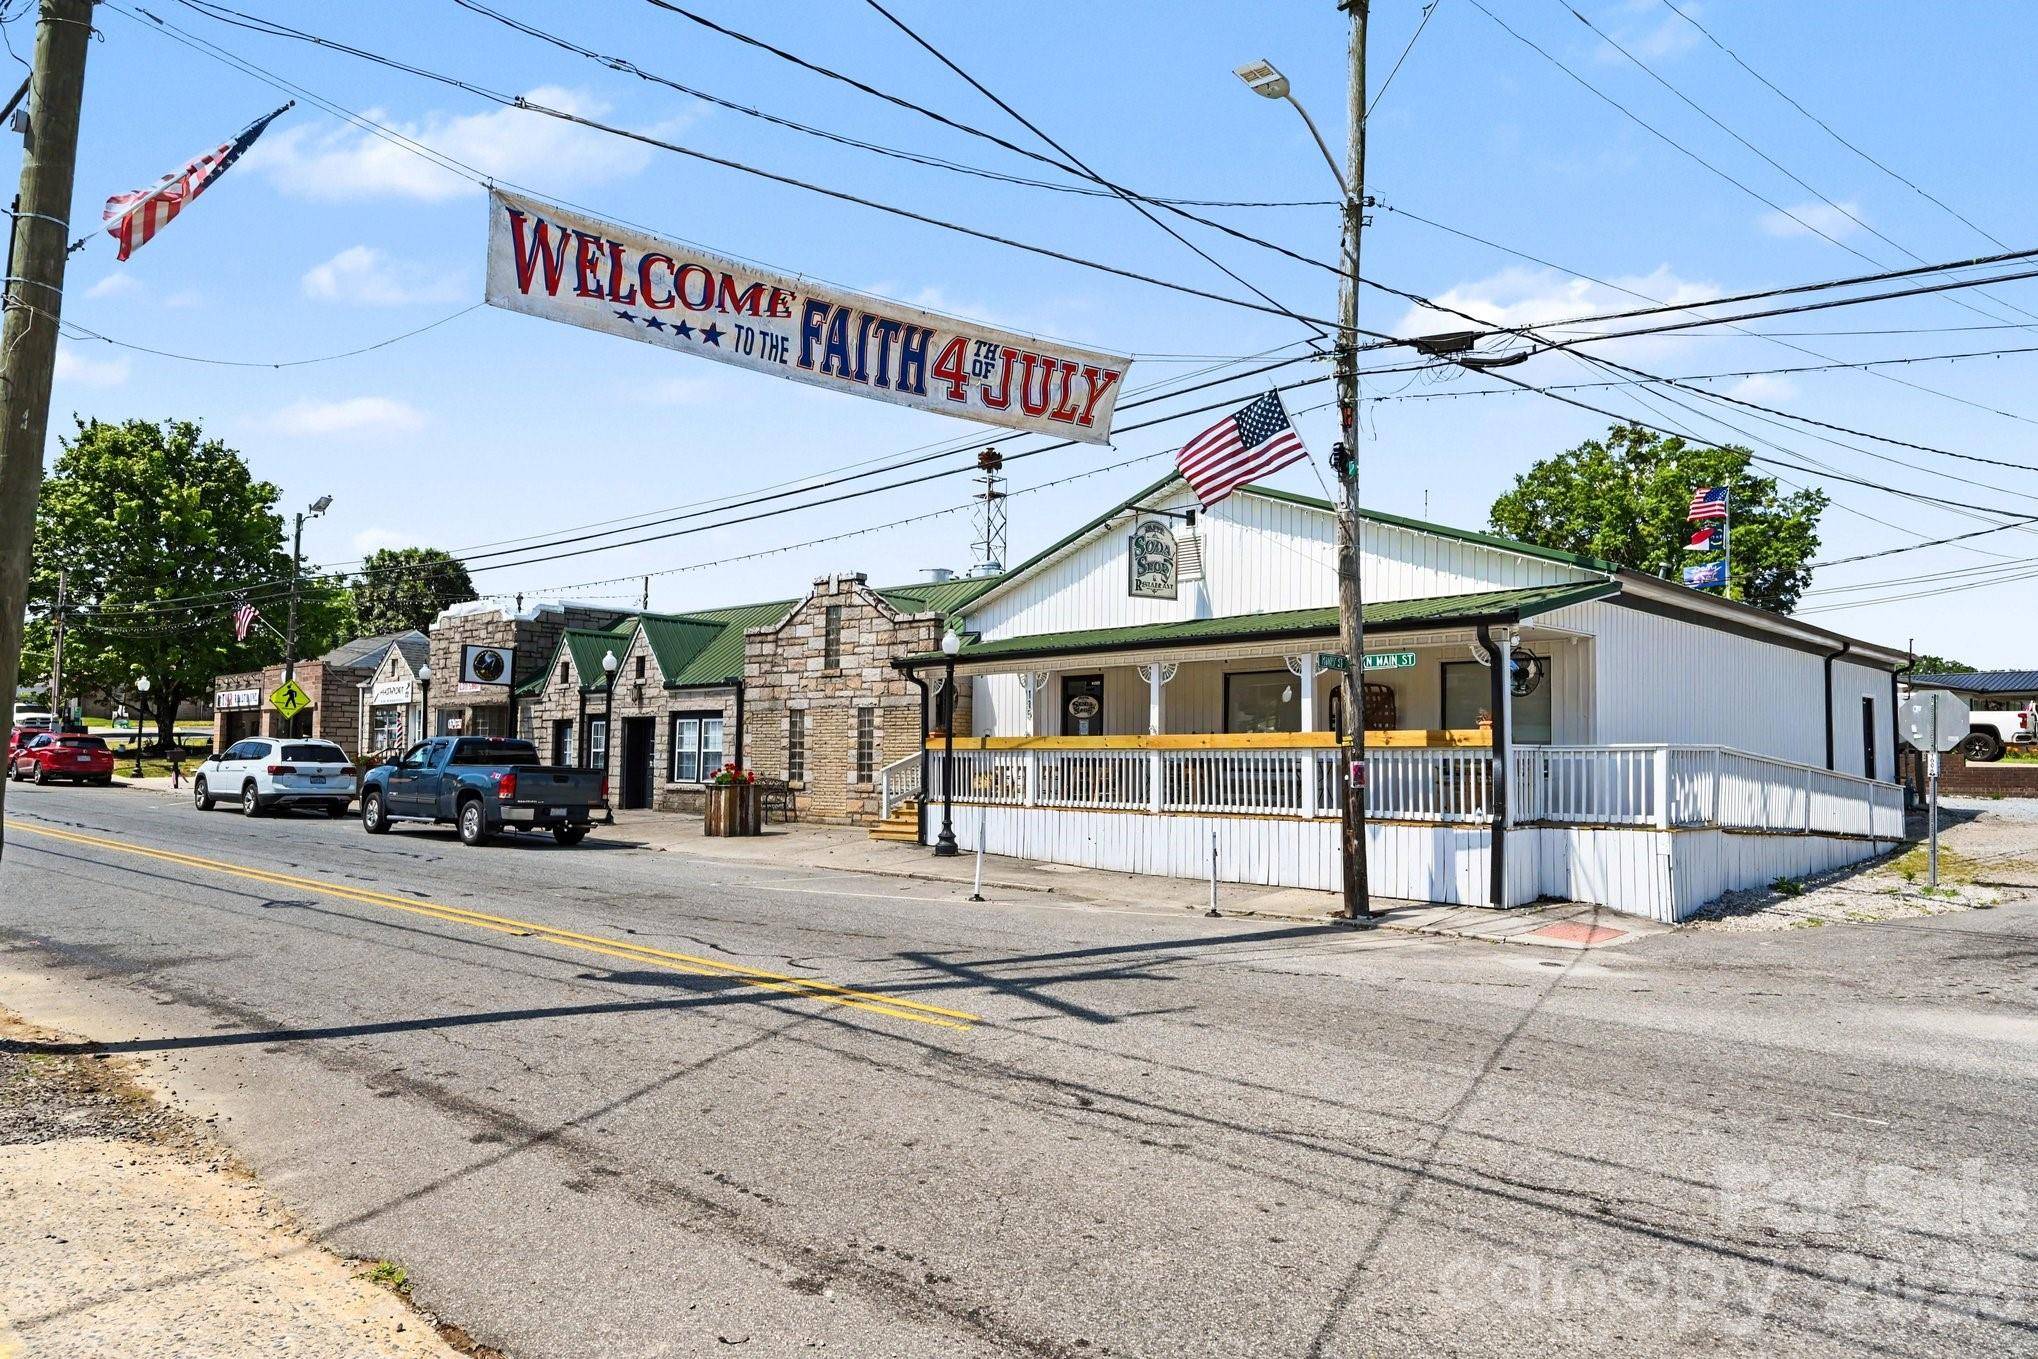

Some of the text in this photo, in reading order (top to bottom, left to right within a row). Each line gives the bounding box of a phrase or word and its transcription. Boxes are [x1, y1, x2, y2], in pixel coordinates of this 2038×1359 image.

[505, 206, 797, 318] WELCOME
[734, 323, 755, 355] TO
[759, 330, 789, 364] THE
[797, 297, 937, 397] FAITH
[971, 346, 1121, 428] OF JULY
[1135, 535, 1171, 558] SODA
[1366, 654, 1413, 667] N MAIN ST
